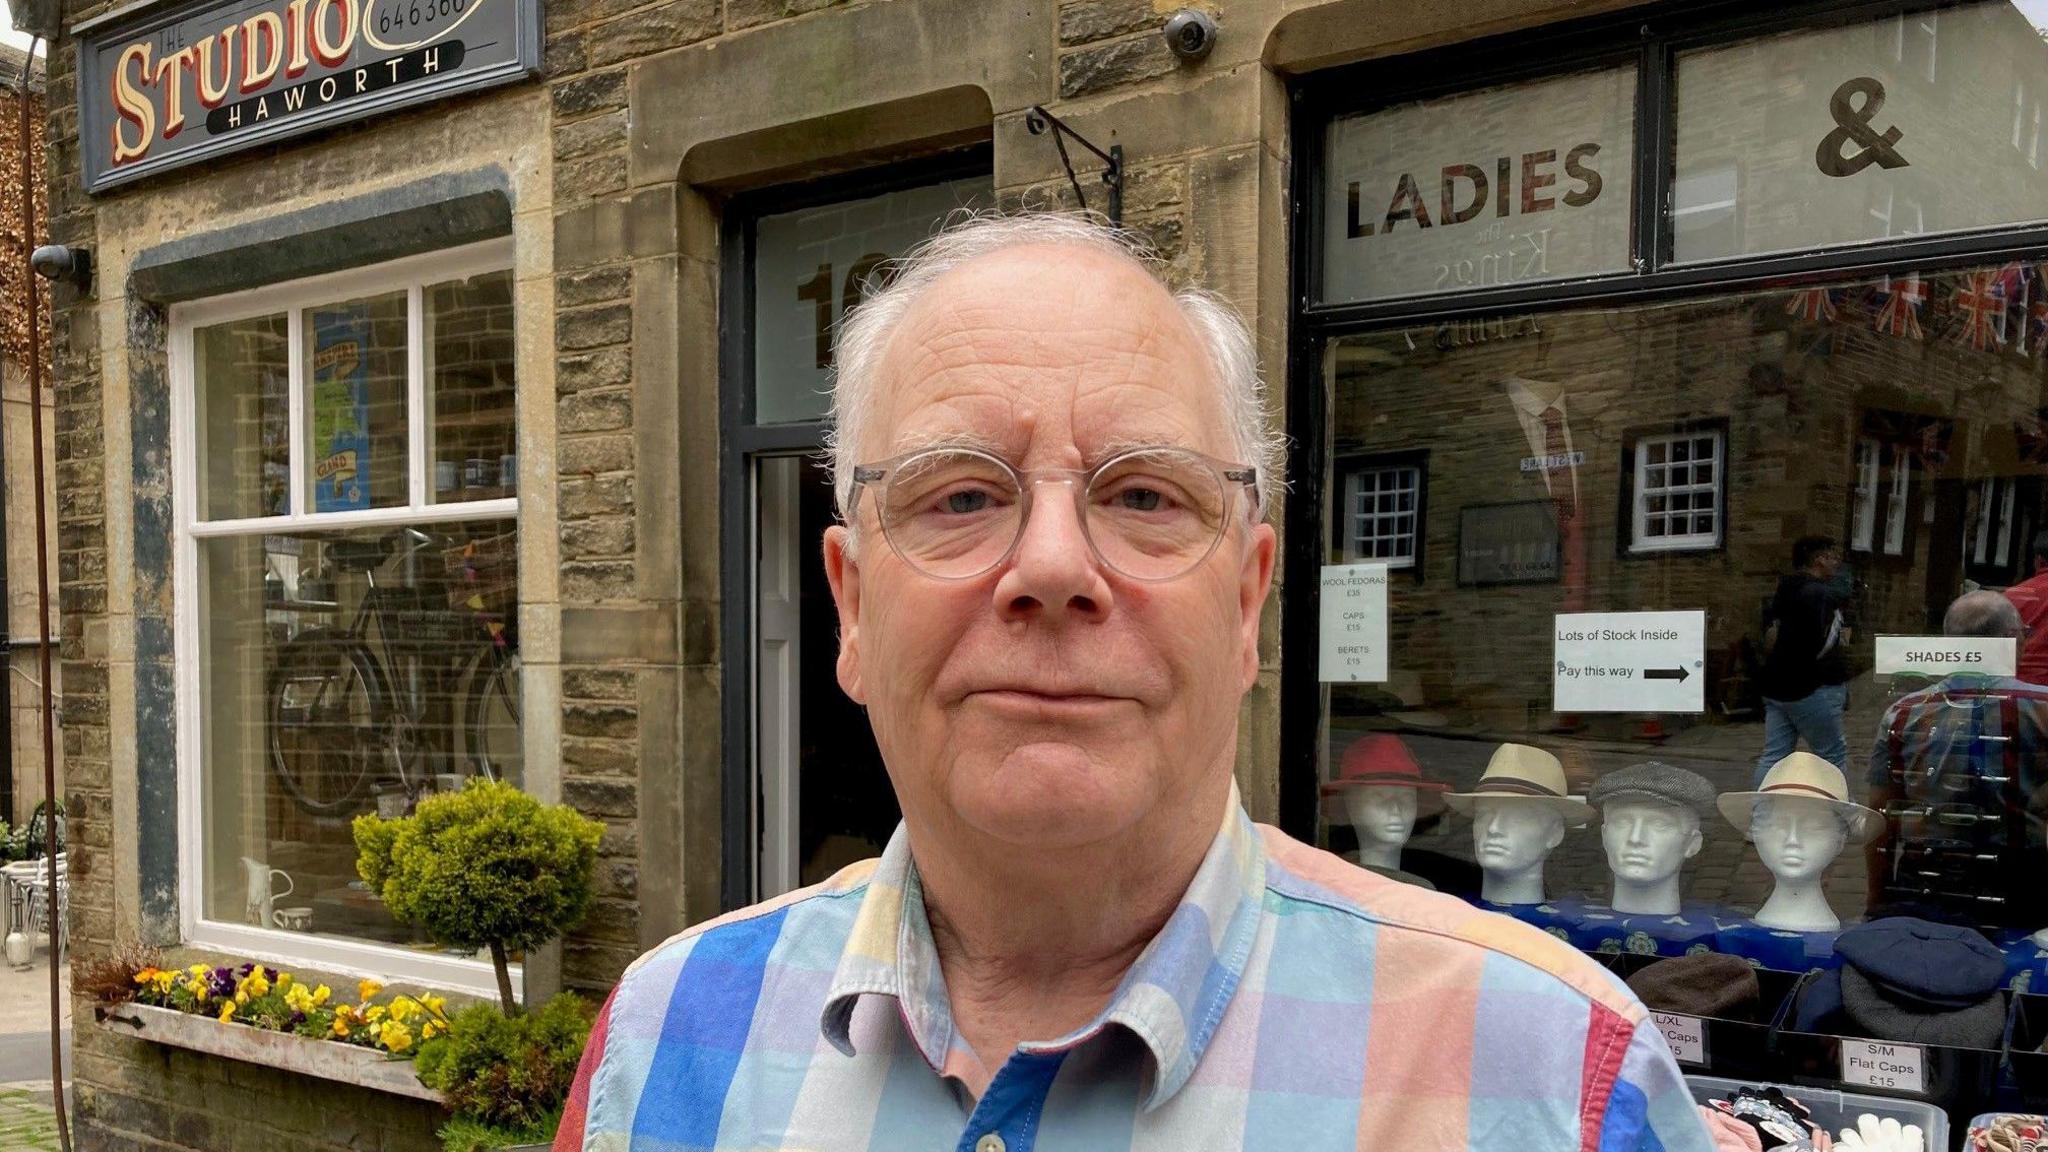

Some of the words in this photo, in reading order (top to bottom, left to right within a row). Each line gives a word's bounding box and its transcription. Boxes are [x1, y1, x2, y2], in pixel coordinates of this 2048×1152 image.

[159, 24, 185, 54] THE
[112, 0, 359, 167] STUDIO
[228, 47, 439, 128] HAWORTH
[1815, 76, 1910, 177] &
[1347, 142, 1603, 239] LADIES
[1323, 578, 1345, 586] WOOL
[1347, 576, 1386, 585] FEDORAS
[1342, 612, 1365, 620] CAPS
[1558, 630, 1584, 641] Lots
[1587, 629, 1600, 641] of
[1602, 629, 1637, 641] Stock
[1641, 629, 1678, 640] Inside
[1337, 646, 1369, 654] BERETS
[1905, 651, 1961, 663] SHADES
[1965, 651, 1982, 663] £5
[1557, 665, 1581, 679] Pay
[1585, 665, 1606, 677] this
[1609, 667, 1634, 678] way
[1656, 1014, 1683, 1027] L/XL
[1667, 1030, 1699, 1043] Caps
[1867, 1044, 1895, 1056] S/M
[1849, 1057, 1875, 1069] Flat
[1878, 1061, 1914, 1074] Caps
[1869, 1075, 1895, 1087] £15
